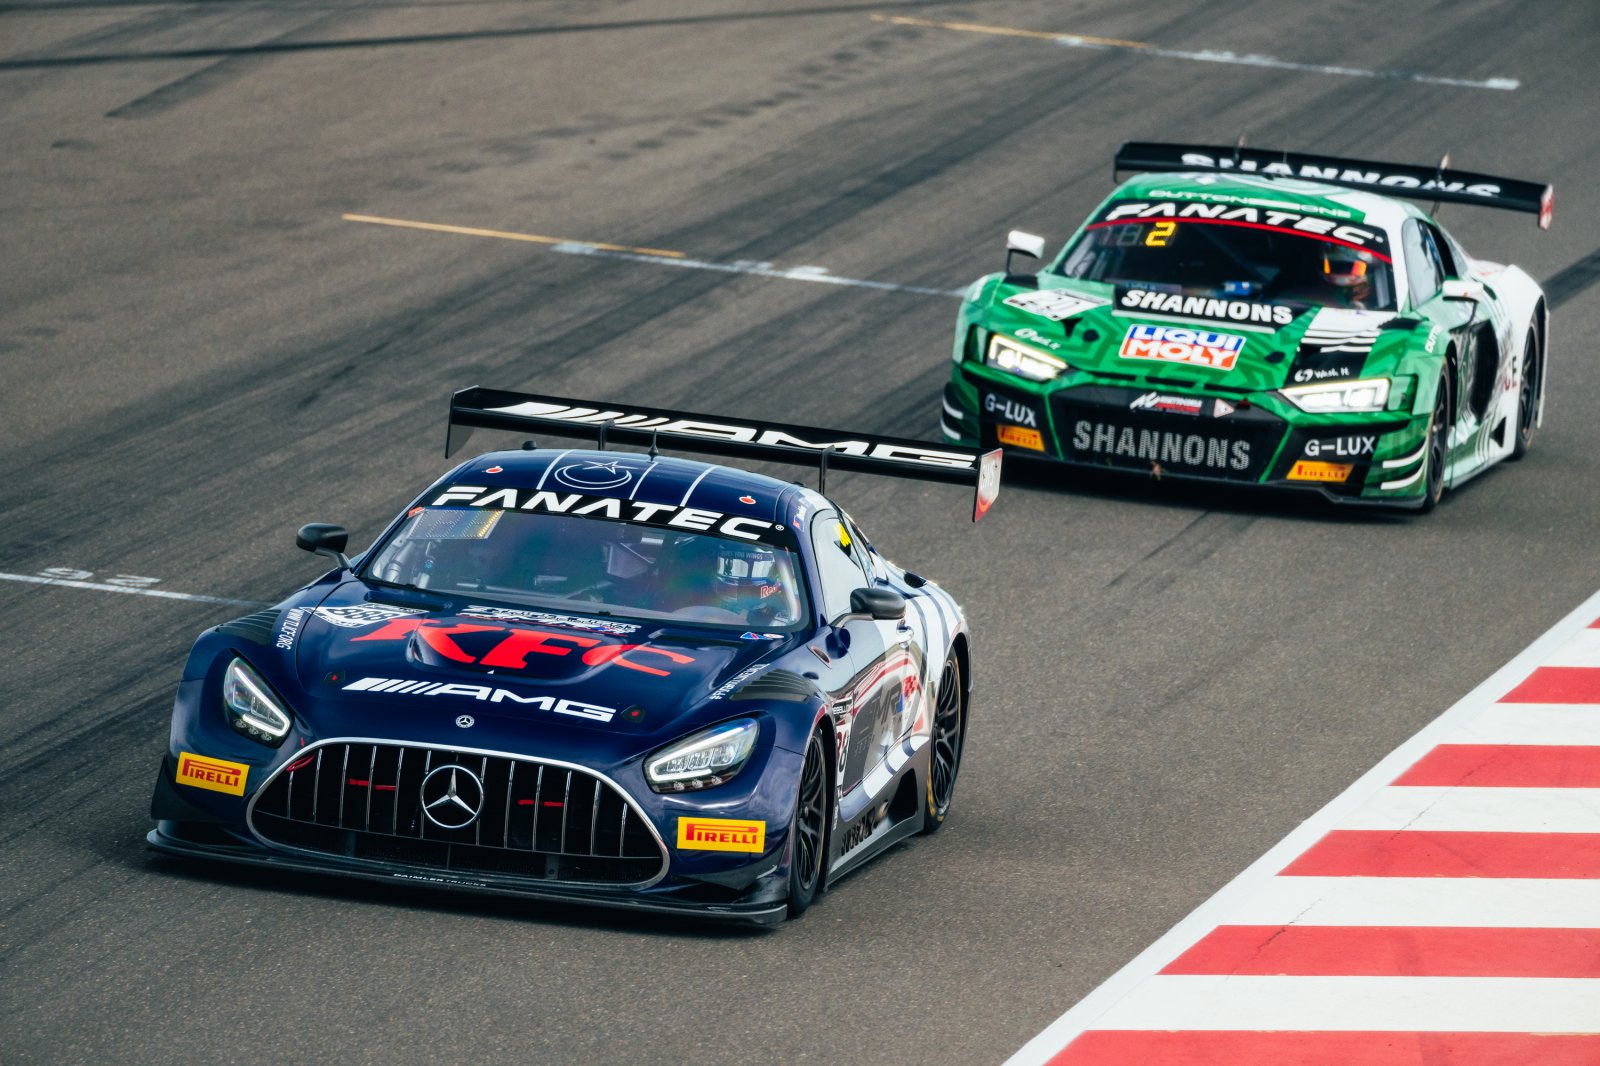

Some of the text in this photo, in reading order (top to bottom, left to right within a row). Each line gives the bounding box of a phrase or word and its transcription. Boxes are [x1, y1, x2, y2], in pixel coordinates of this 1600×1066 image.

[1105, 202, 1374, 246] FANATEC
[1120, 289, 1294, 326] SHANNONS
[1124, 337, 1239, 371] MOLY
[1132, 326, 1245, 349] LIQUI
[985, 393, 1037, 427] G-LUX
[1073, 420, 1251, 472] SHANNONS
[1305, 436, 1376, 457] G-LUX
[433, 486, 773, 542] FANATEC
[350, 617, 695, 677] KFC
[428, 682, 617, 723] AMG
[182, 757, 241, 788] PIRELLI
[685, 822, 759, 846] PIRELLI
